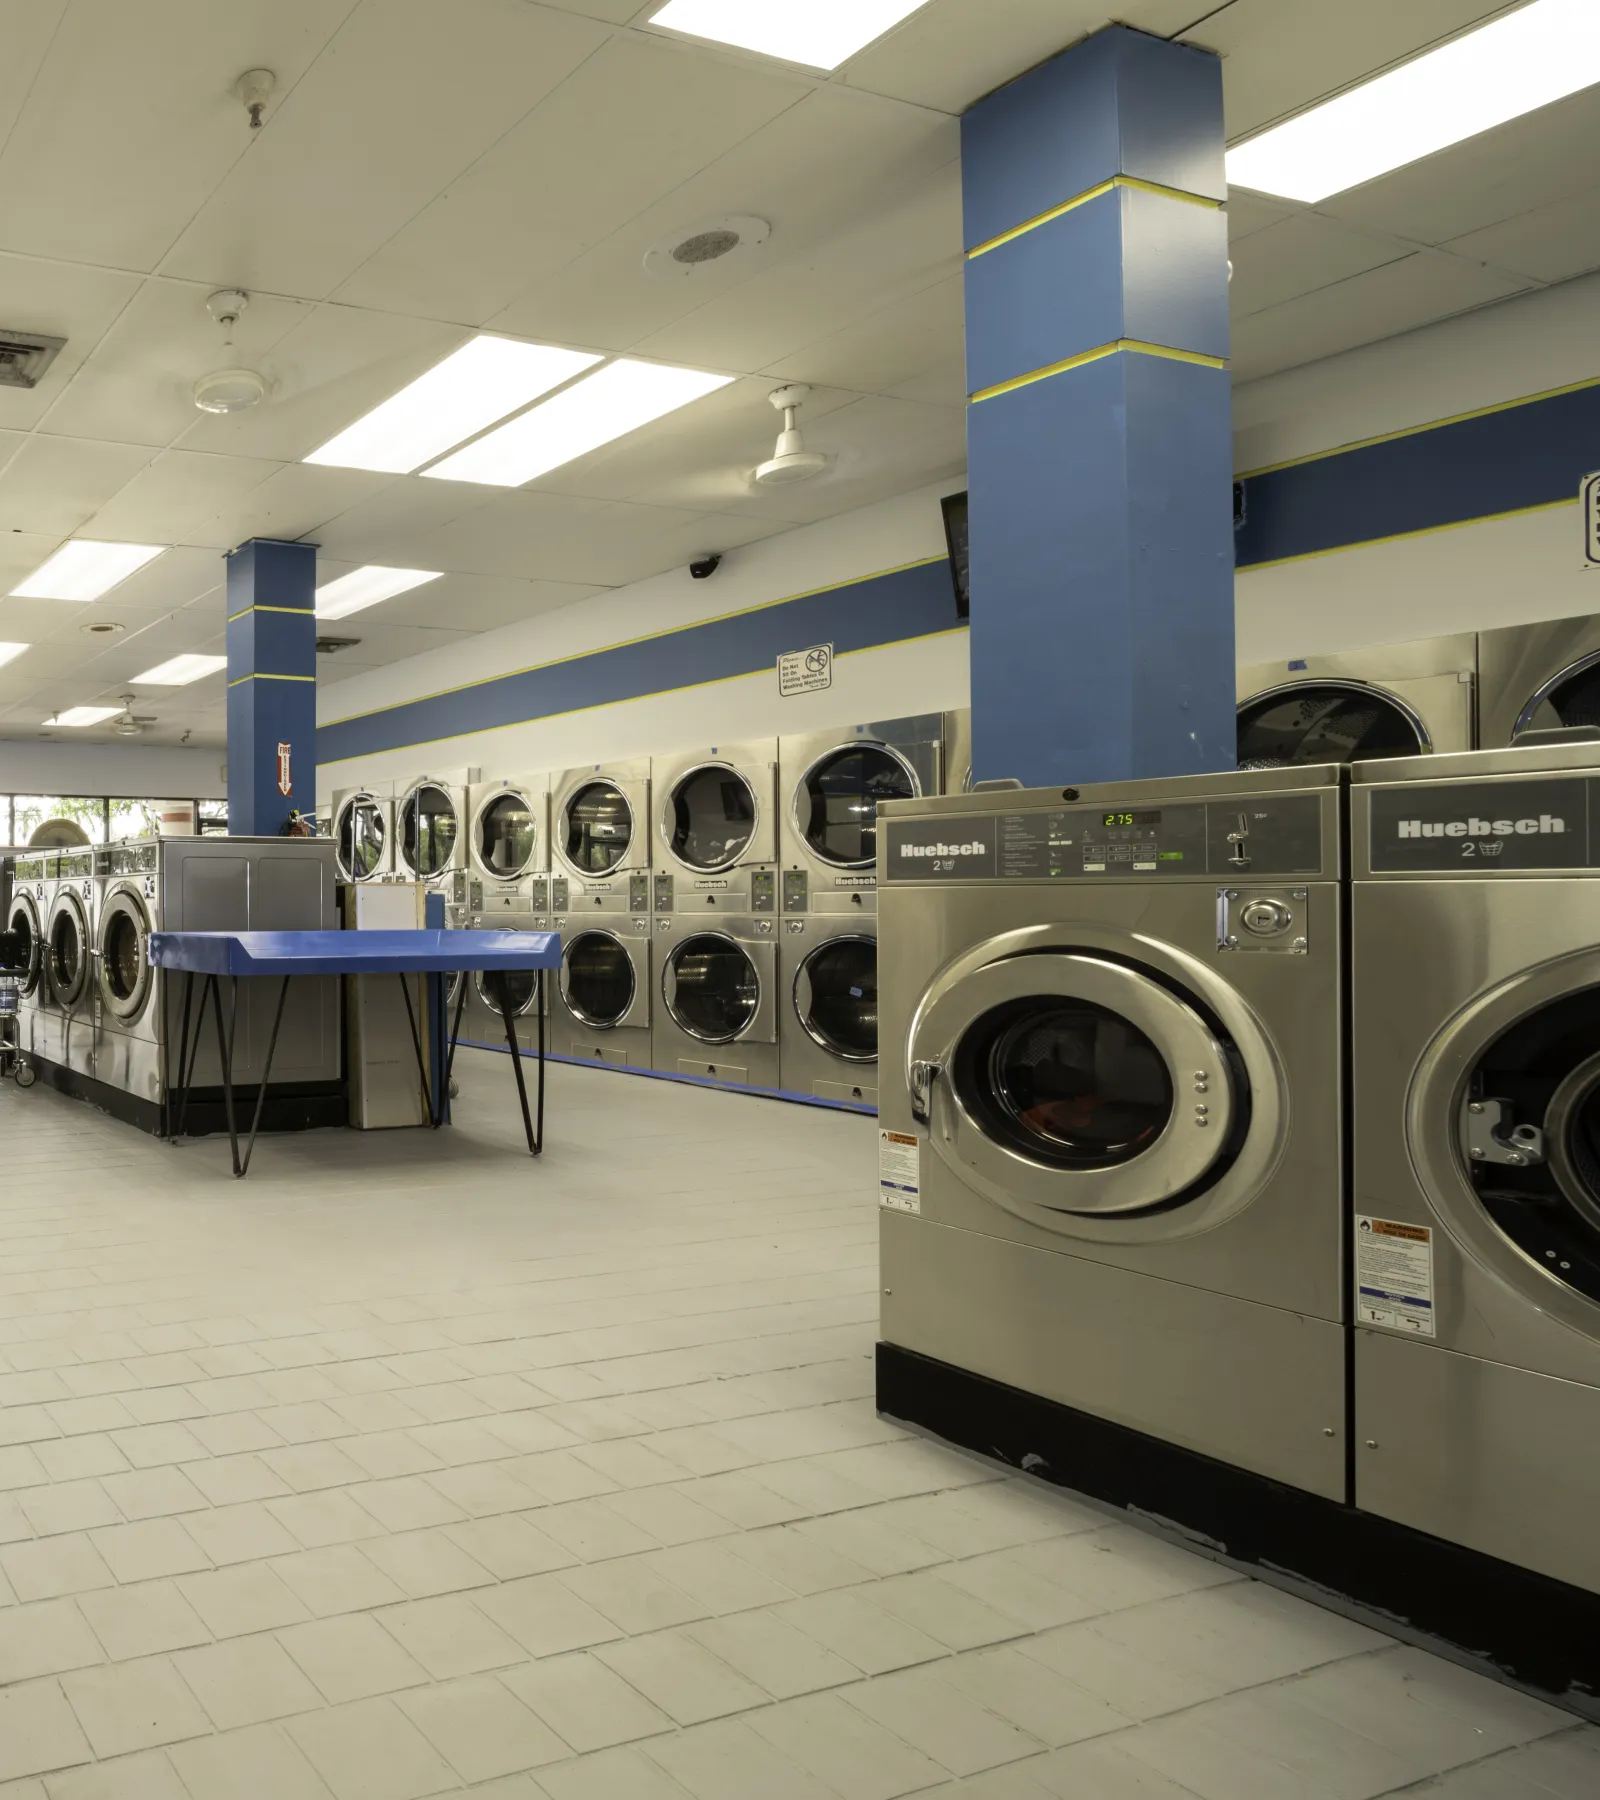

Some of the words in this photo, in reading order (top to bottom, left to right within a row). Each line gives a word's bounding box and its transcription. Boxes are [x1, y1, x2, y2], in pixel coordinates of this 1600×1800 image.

[1105, 814, 1133, 826] 2.75
[1398, 815, 1565, 838] Huebsch
[901, 841, 986, 857] Huebsch
[1461, 842, 1475, 857] 2
[933, 860, 941, 871] 2
[835, 876, 876, 886] Huebsch
